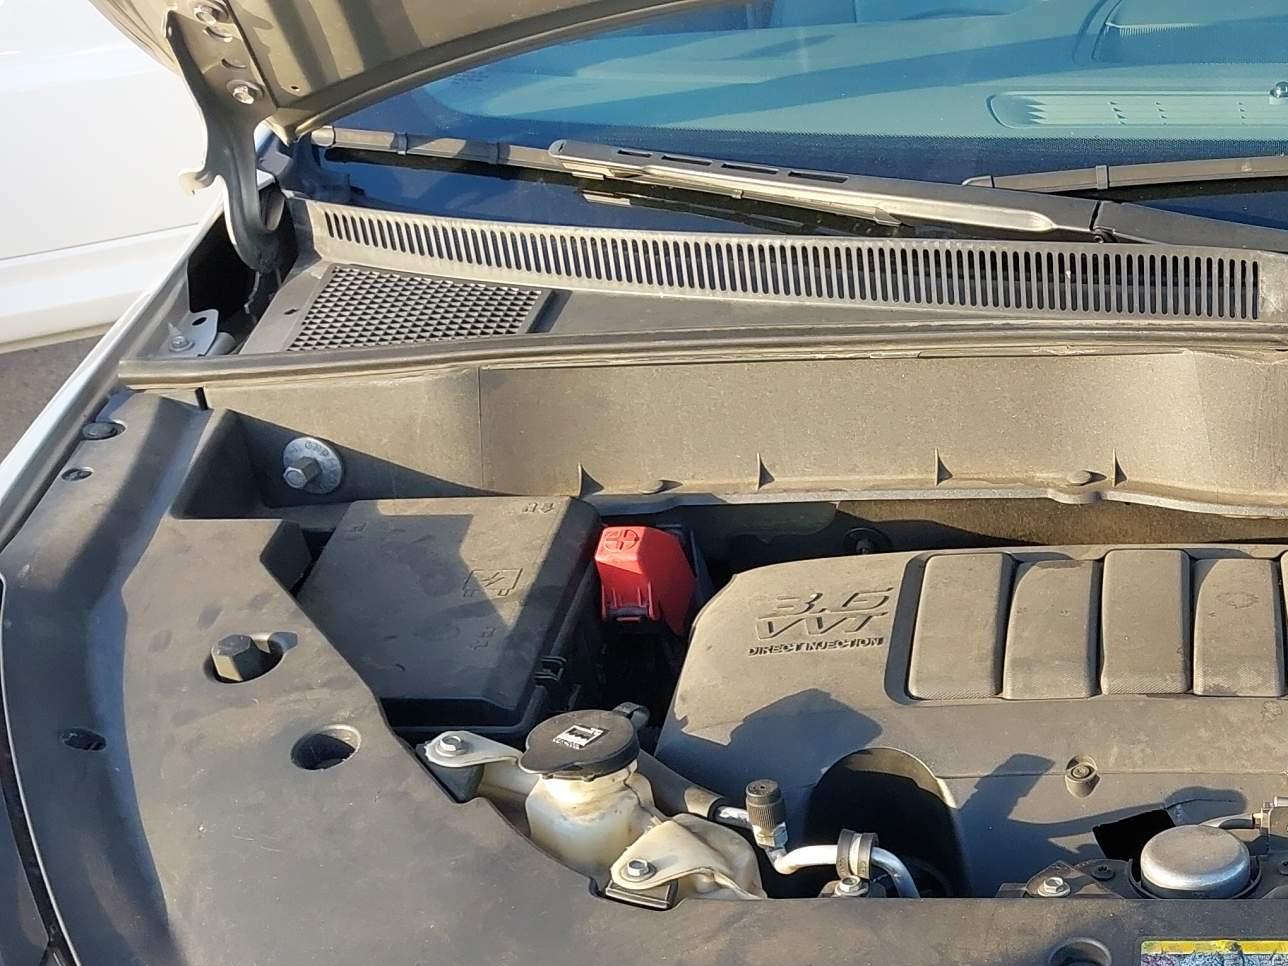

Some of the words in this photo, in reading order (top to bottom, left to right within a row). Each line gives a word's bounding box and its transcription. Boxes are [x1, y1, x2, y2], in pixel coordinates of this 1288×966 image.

[774, 586, 895, 617] 3.6
[755, 611, 890, 641] VVT
[749, 642, 803, 656] DIRECT
[803, 638, 885, 653] INJECTION
